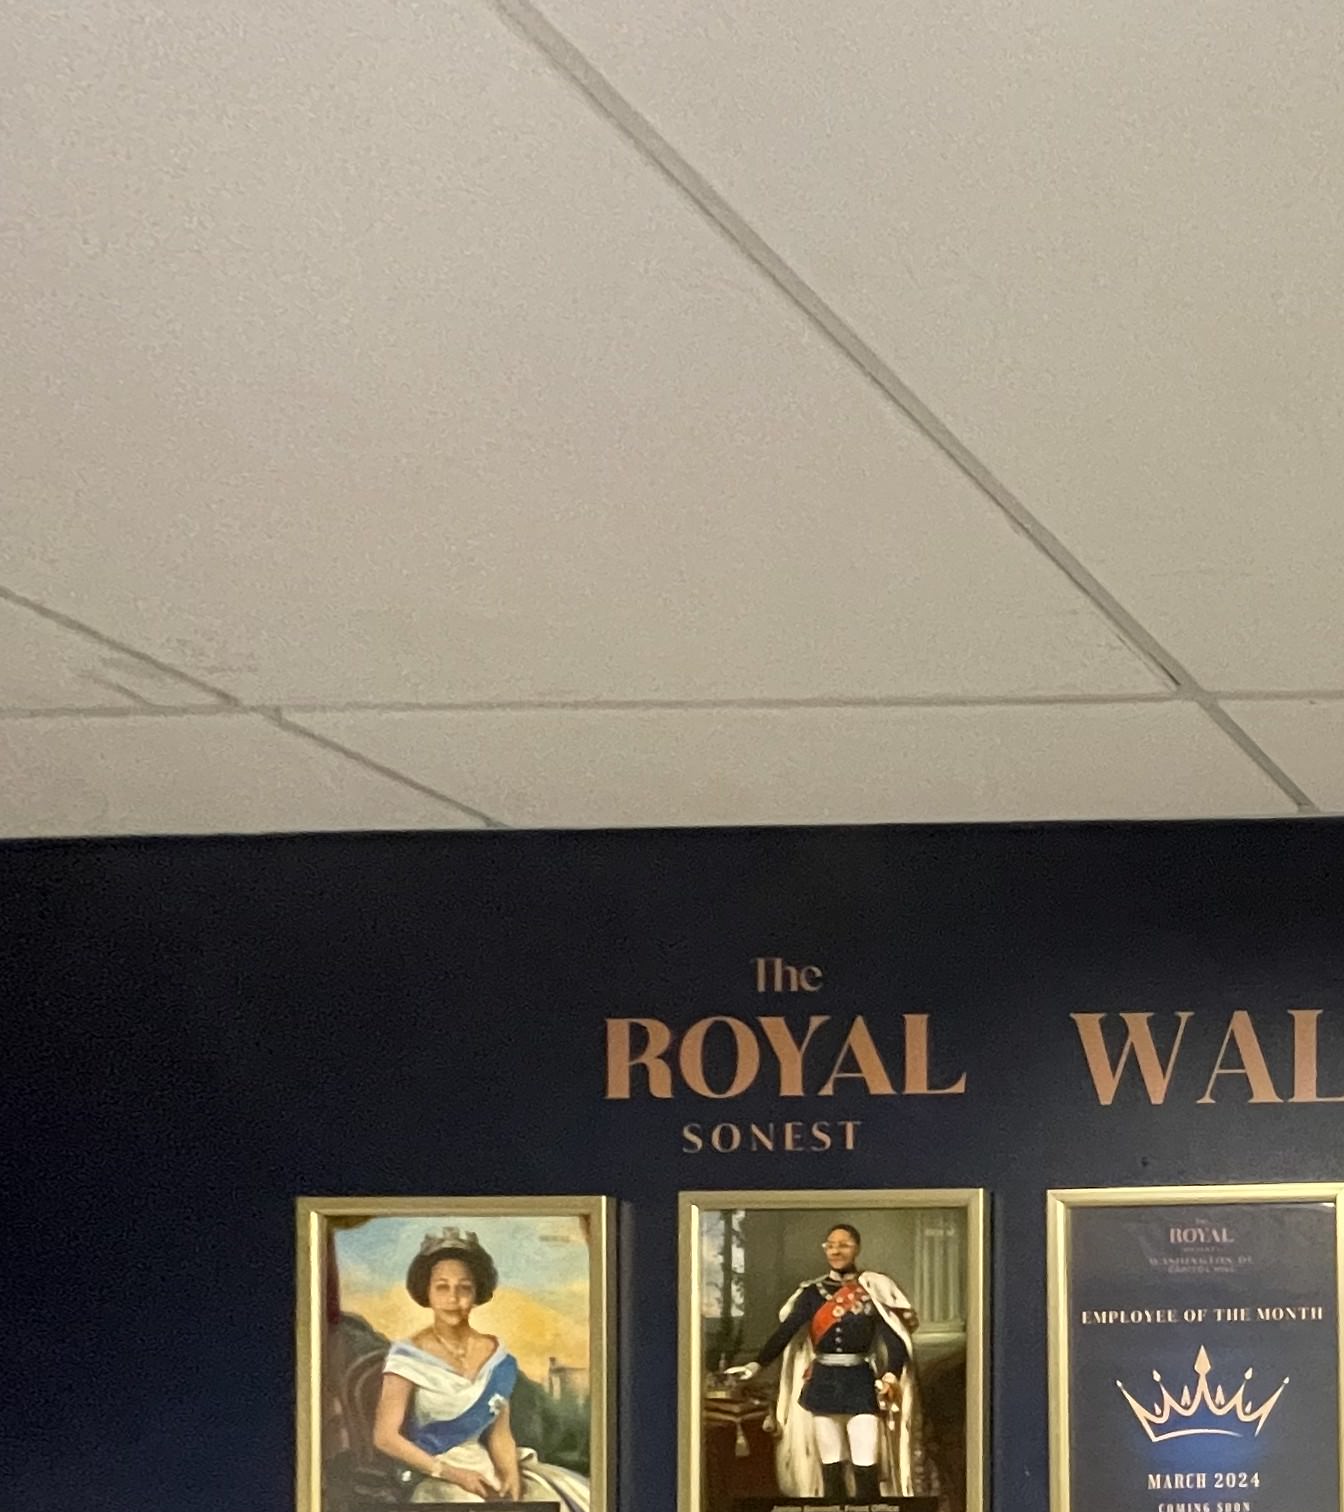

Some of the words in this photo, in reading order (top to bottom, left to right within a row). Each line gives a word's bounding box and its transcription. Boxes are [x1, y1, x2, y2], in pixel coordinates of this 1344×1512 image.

[751, 957, 824, 993] The
[607, 1014, 966, 1099] ROYAL
[681, 1120, 865, 1153] SONEST
[1169, 1227, 1235, 1244] ROYAL
[1082, 1310, 1177, 1323] EMPLOYEE
[1184, 1310, 1206, 1321] OF
[1216, 1309, 1249, 1321] THE
[1257, 1307, 1323, 1320] MONTH
[1149, 1473, 1206, 1488] MARCH
[1214, 1472, 1259, 1488] 2024
[1217, 1502, 1250, 1512] SOON
